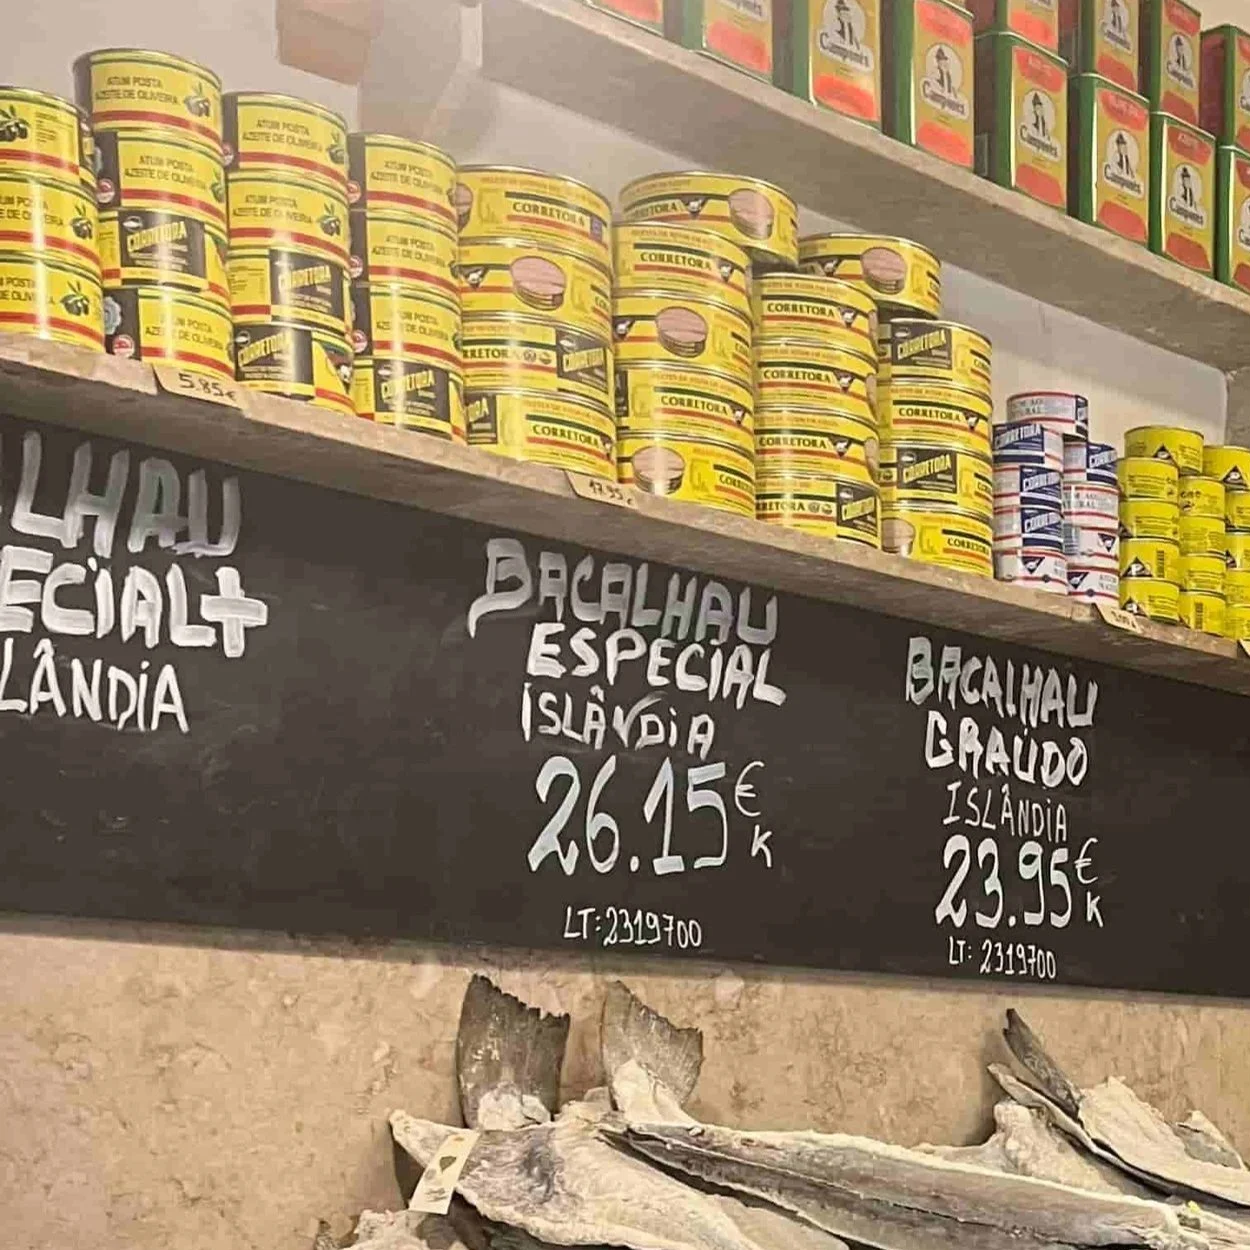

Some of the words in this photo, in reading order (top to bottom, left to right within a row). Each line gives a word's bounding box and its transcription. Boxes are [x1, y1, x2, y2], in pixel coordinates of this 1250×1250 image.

[513, 202, 585, 226] CORRETORA
[640, 252, 712, 271] CORRETORA
[767, 303, 835, 317] CORRETORA
[764, 370, 831, 383] CORRETORA
[661, 396, 728, 415] CORRETORA
[899, 407, 961, 422] CORRETORA
[533, 424, 599, 448] CORRETORA
[759, 437, 827, 449] CORRETORA
[10, 431, 242, 558] LHAU
[467, 538, 778, 645] BACALHAU
[526, 621, 787, 709] ESPECIAL
[905, 636, 1099, 729] BACALHAU
[527, 754, 729, 876] 26.15
[734, 761, 766, 818] €
[943, 781, 1067, 843] ISLÂNDIA
[935, 834, 1072, 929] 23.95
[1074, 837, 1098, 884] €
